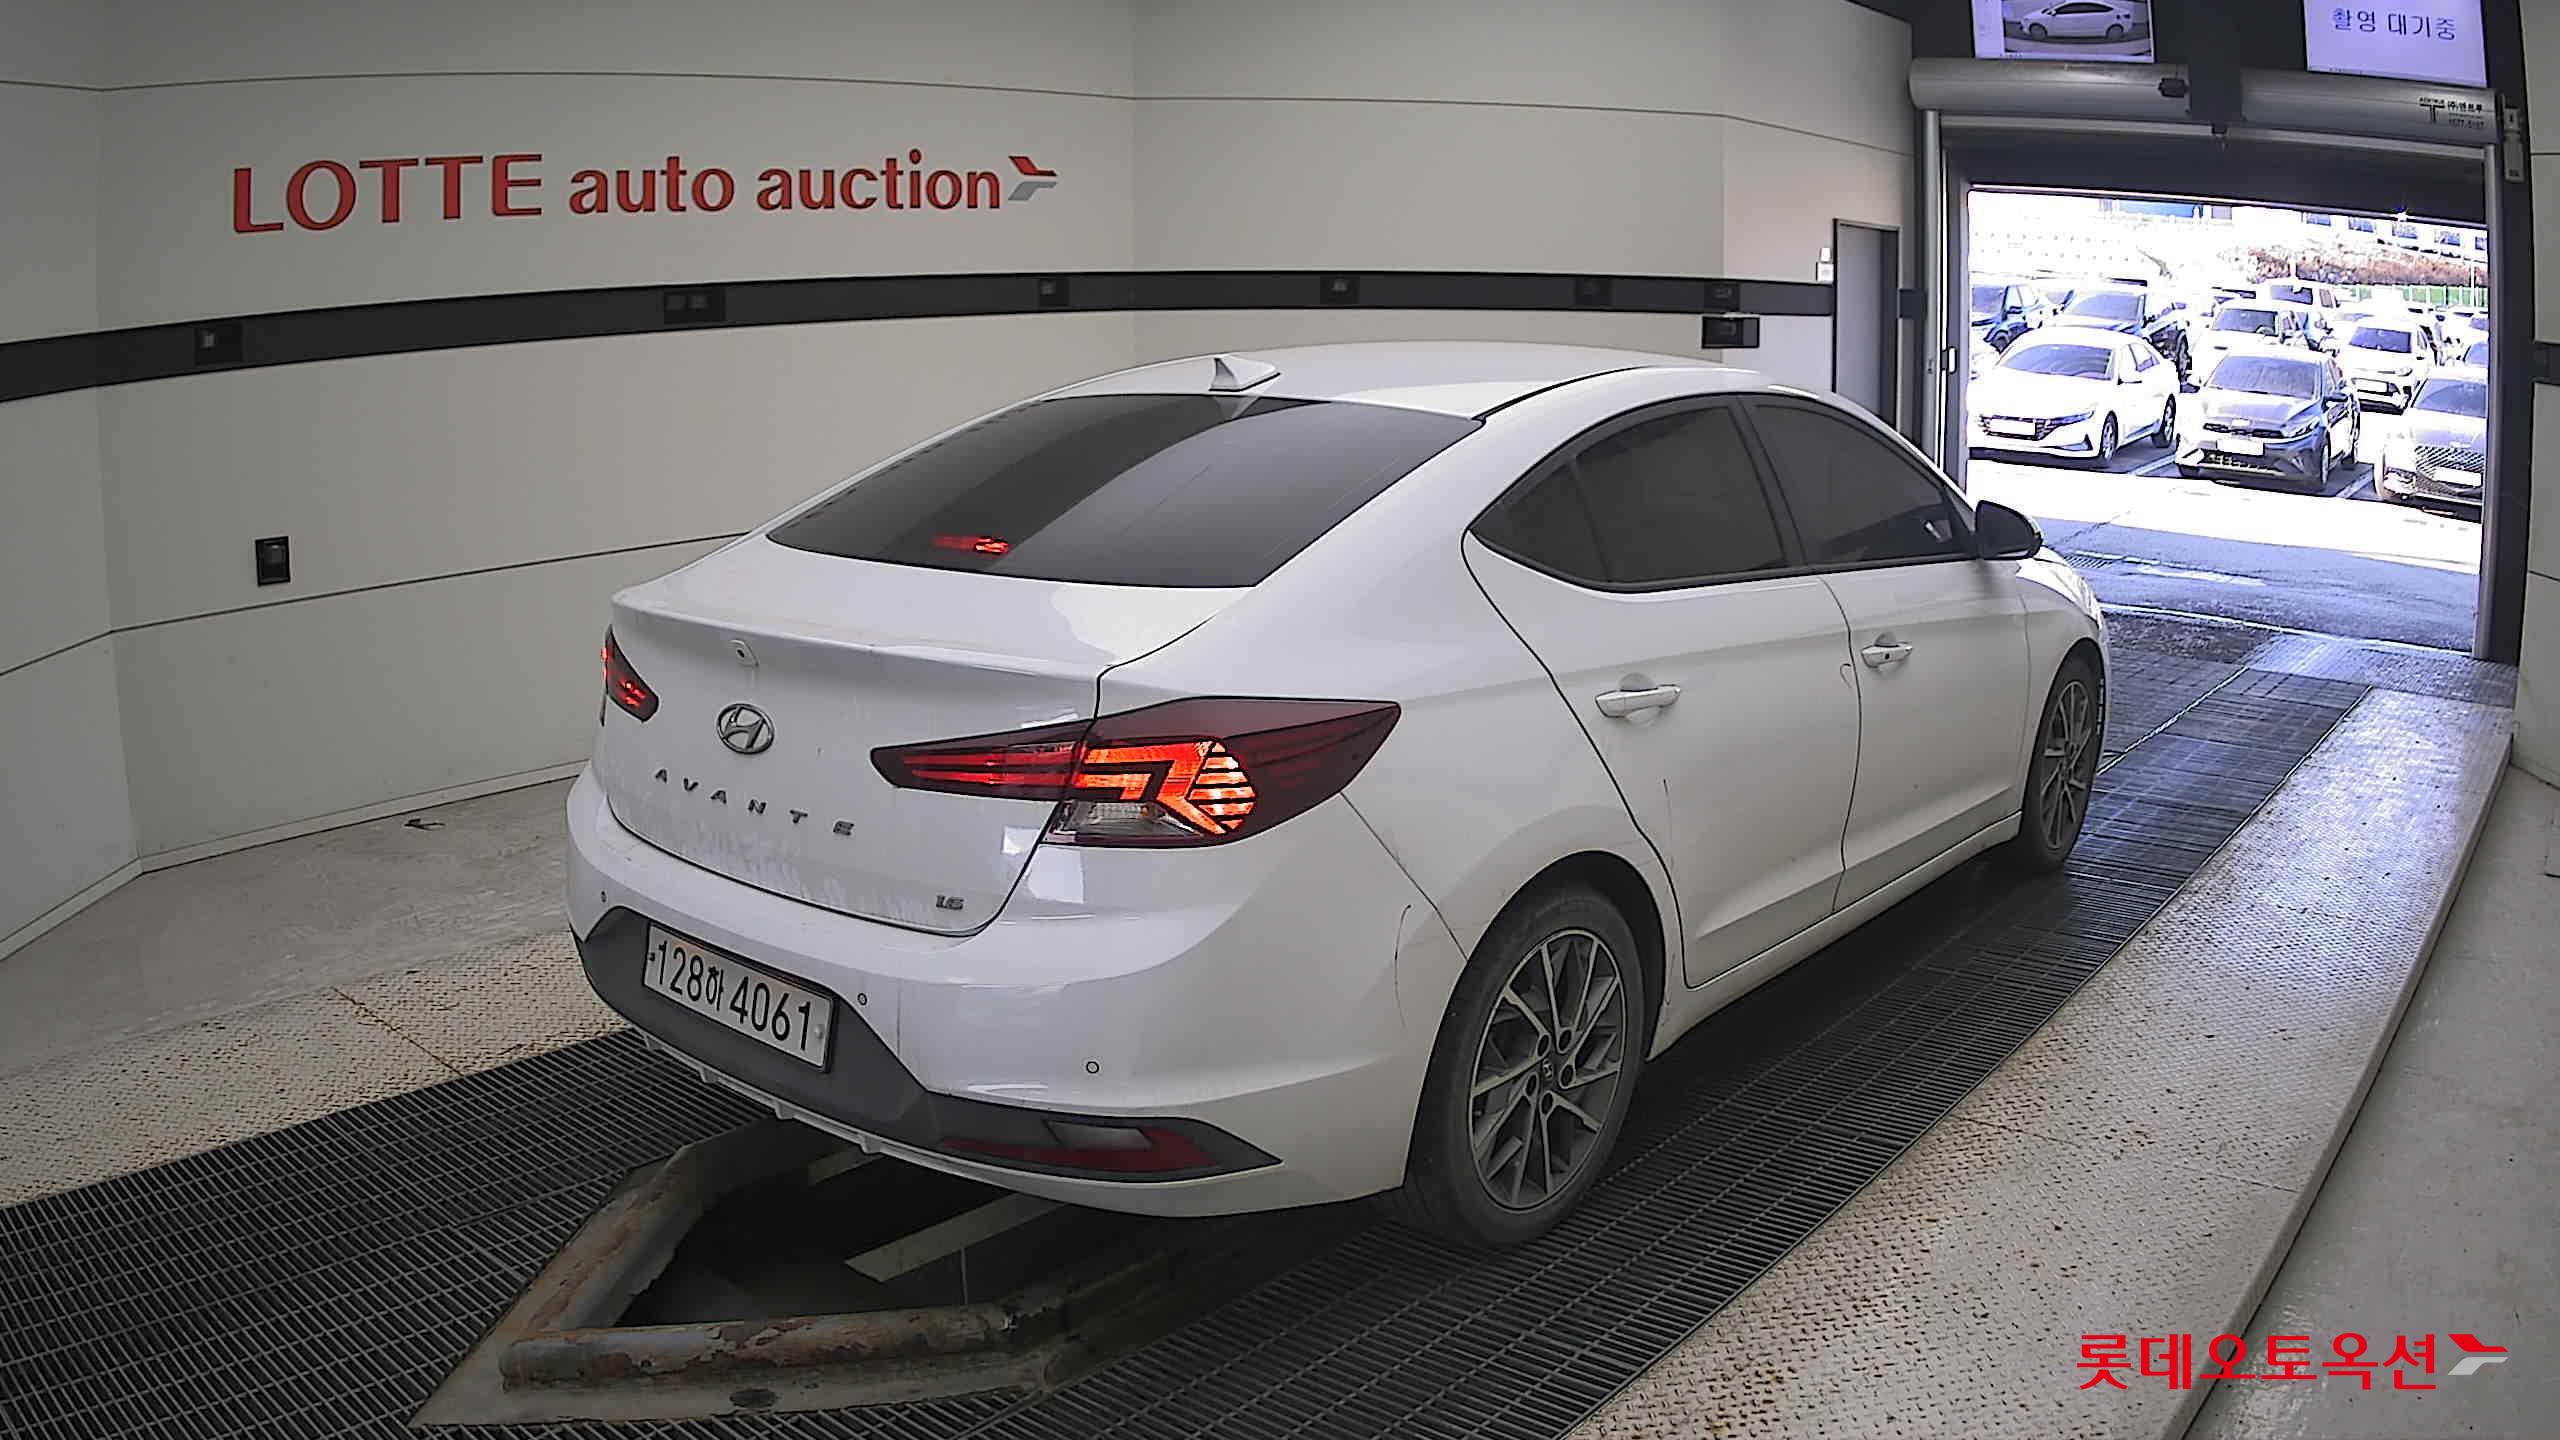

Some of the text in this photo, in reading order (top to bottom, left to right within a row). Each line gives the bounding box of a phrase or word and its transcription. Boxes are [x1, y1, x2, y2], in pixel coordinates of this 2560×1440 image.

[2387, 13, 2457, 41] 대기중
[234, 148, 1002, 233] LOTTE auto auction
[654, 768, 856, 836] AVANTE
[658, 940, 811, 1052] 128하 4061
